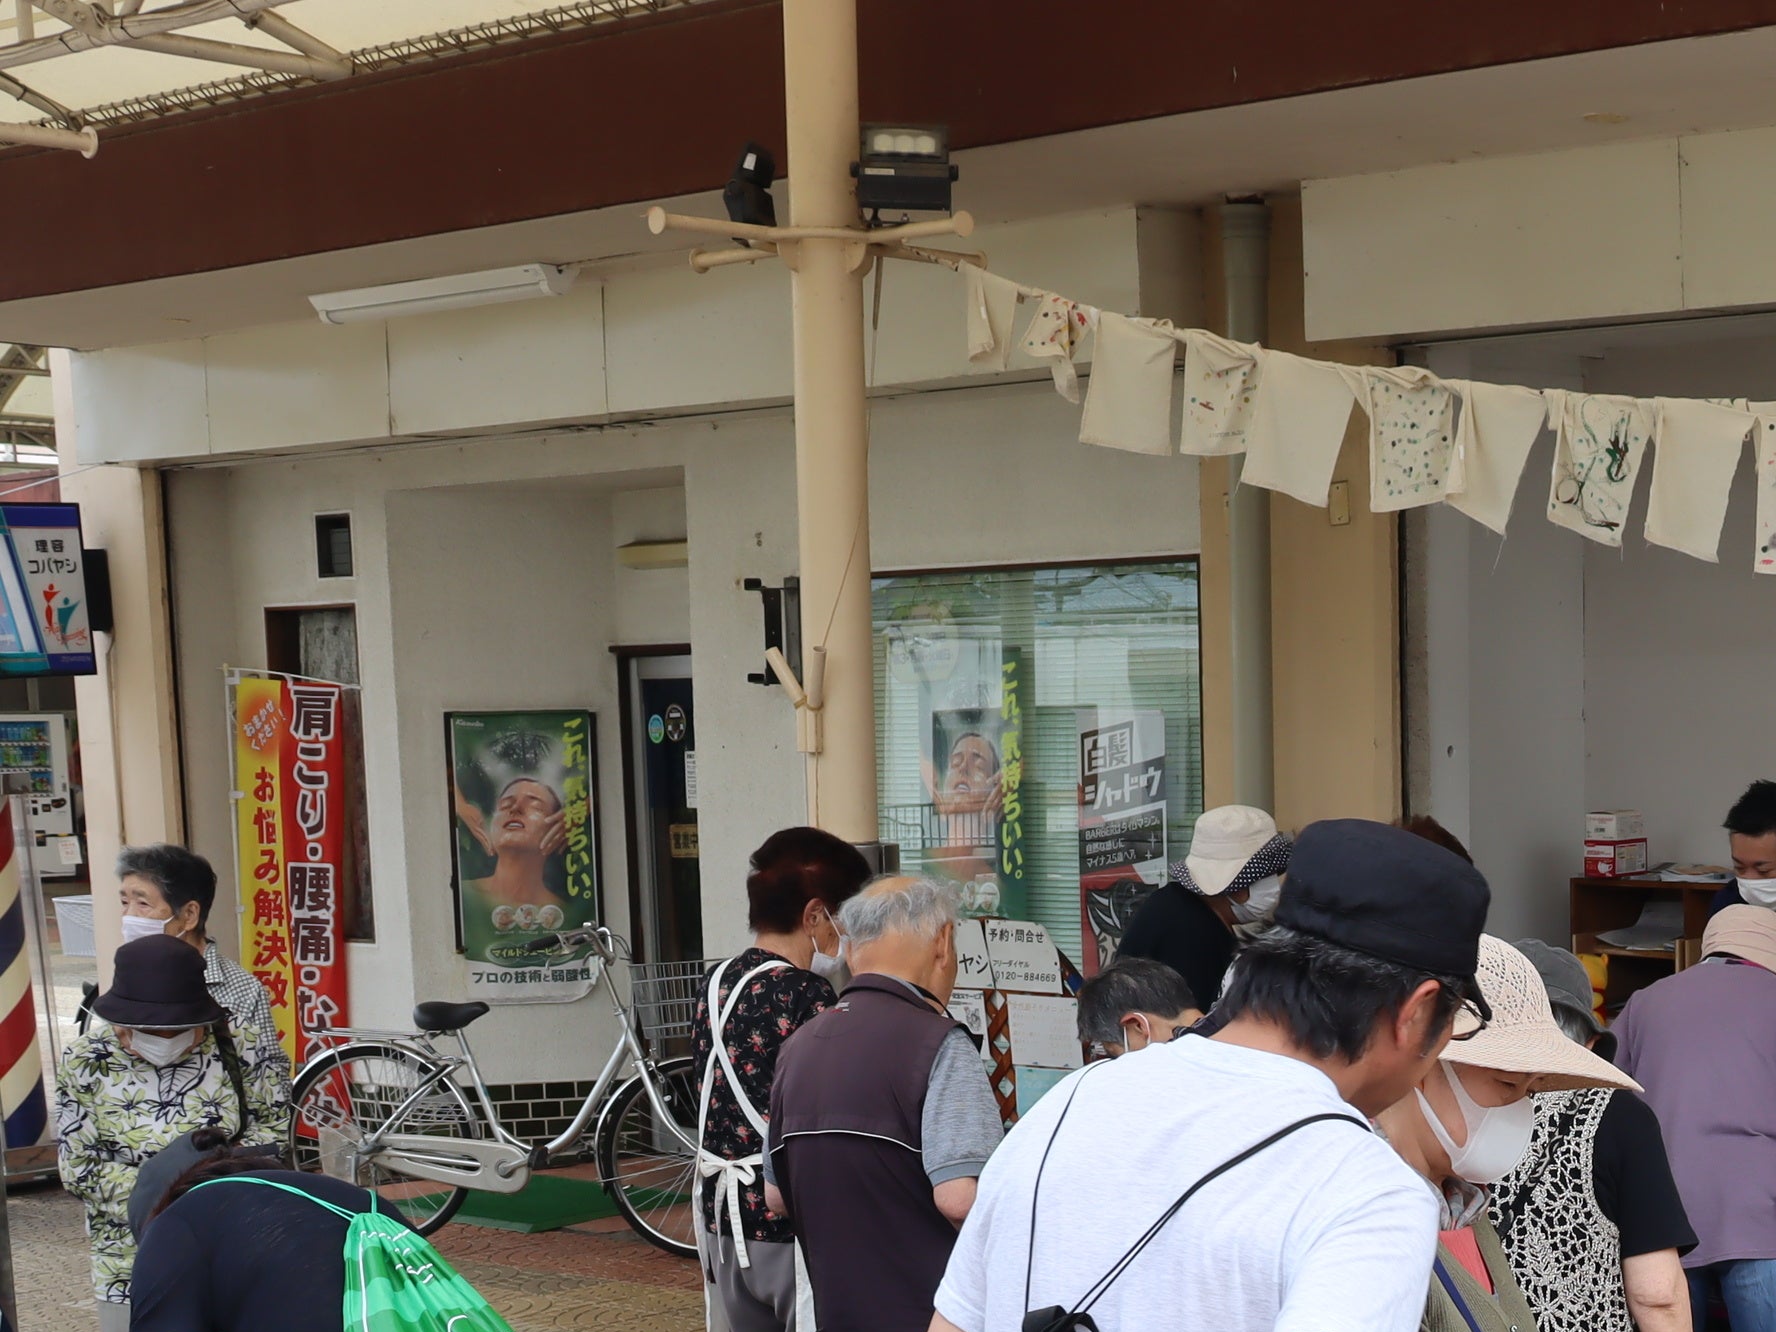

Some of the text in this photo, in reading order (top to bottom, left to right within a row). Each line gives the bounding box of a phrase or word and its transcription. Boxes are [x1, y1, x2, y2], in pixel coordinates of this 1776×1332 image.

[35, 539, 64, 553] 理容
[28, 558, 77, 574] コバヤシ
[242, 699, 275, 737] おまかせ
[1001, 661, 1024, 879] これ、気持ちいい。
[1085, 730, 1131, 773] 白髪
[1084, 767, 1162, 810] シャドウ
[562, 717, 592, 899] これ、気持ちいい。
[252, 766, 289, 1042] お悩み解決致
[987, 928, 1045, 944] 予約・問合せ
[992, 959, 1030, 968] フリーダイヤル
[995, 970, 1057, 983] 0120-884669
